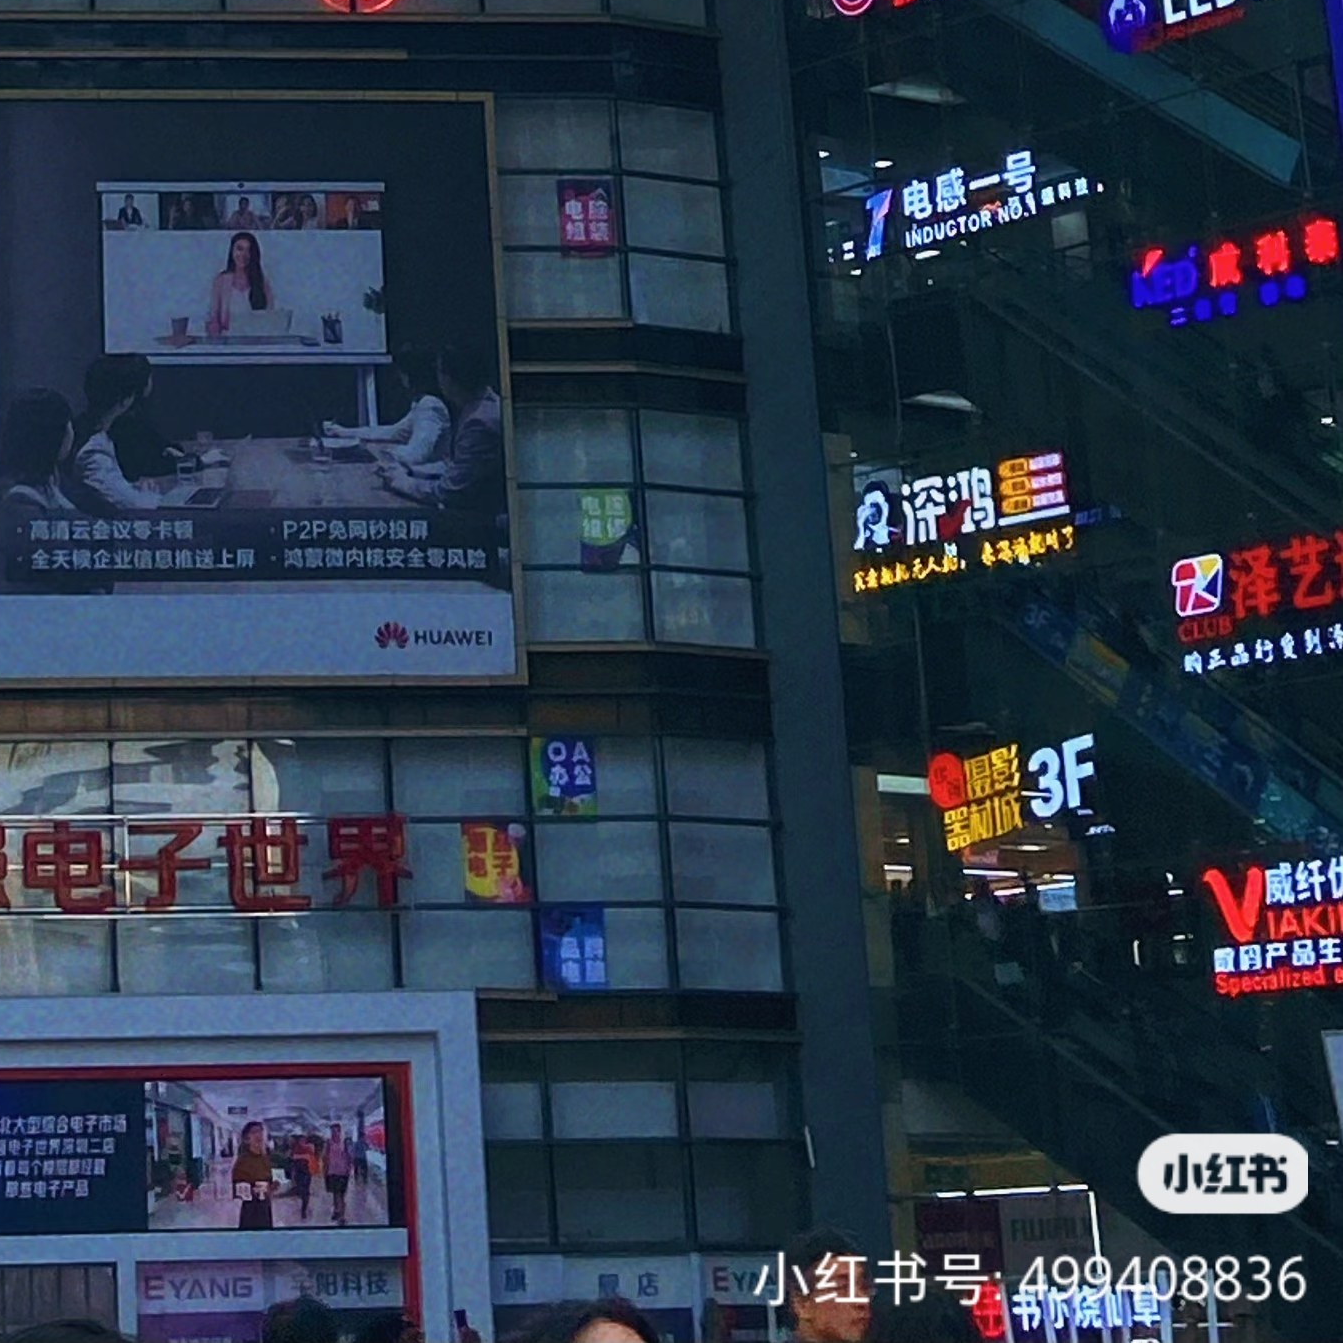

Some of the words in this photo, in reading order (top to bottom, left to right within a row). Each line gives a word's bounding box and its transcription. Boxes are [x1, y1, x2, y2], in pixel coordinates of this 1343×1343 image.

[902, 149, 1036, 220] 电感一号
[905, 209, 993, 249] INDUCTOR
[30, 547, 256, 570] 全天候企业信息推送上屏
[283, 547, 487, 571] 鸿蒙微内核安全零风险
[1229, 531, 1343, 619] 泽艺
[414, 629, 493, 647] HUAWEI
[1176, 616, 1234, 645] CLUB
[1028, 732, 1095, 818] 3F
[1215, 966, 1327, 998] Specialized
[143, 1275, 254, 1301] EYANG
